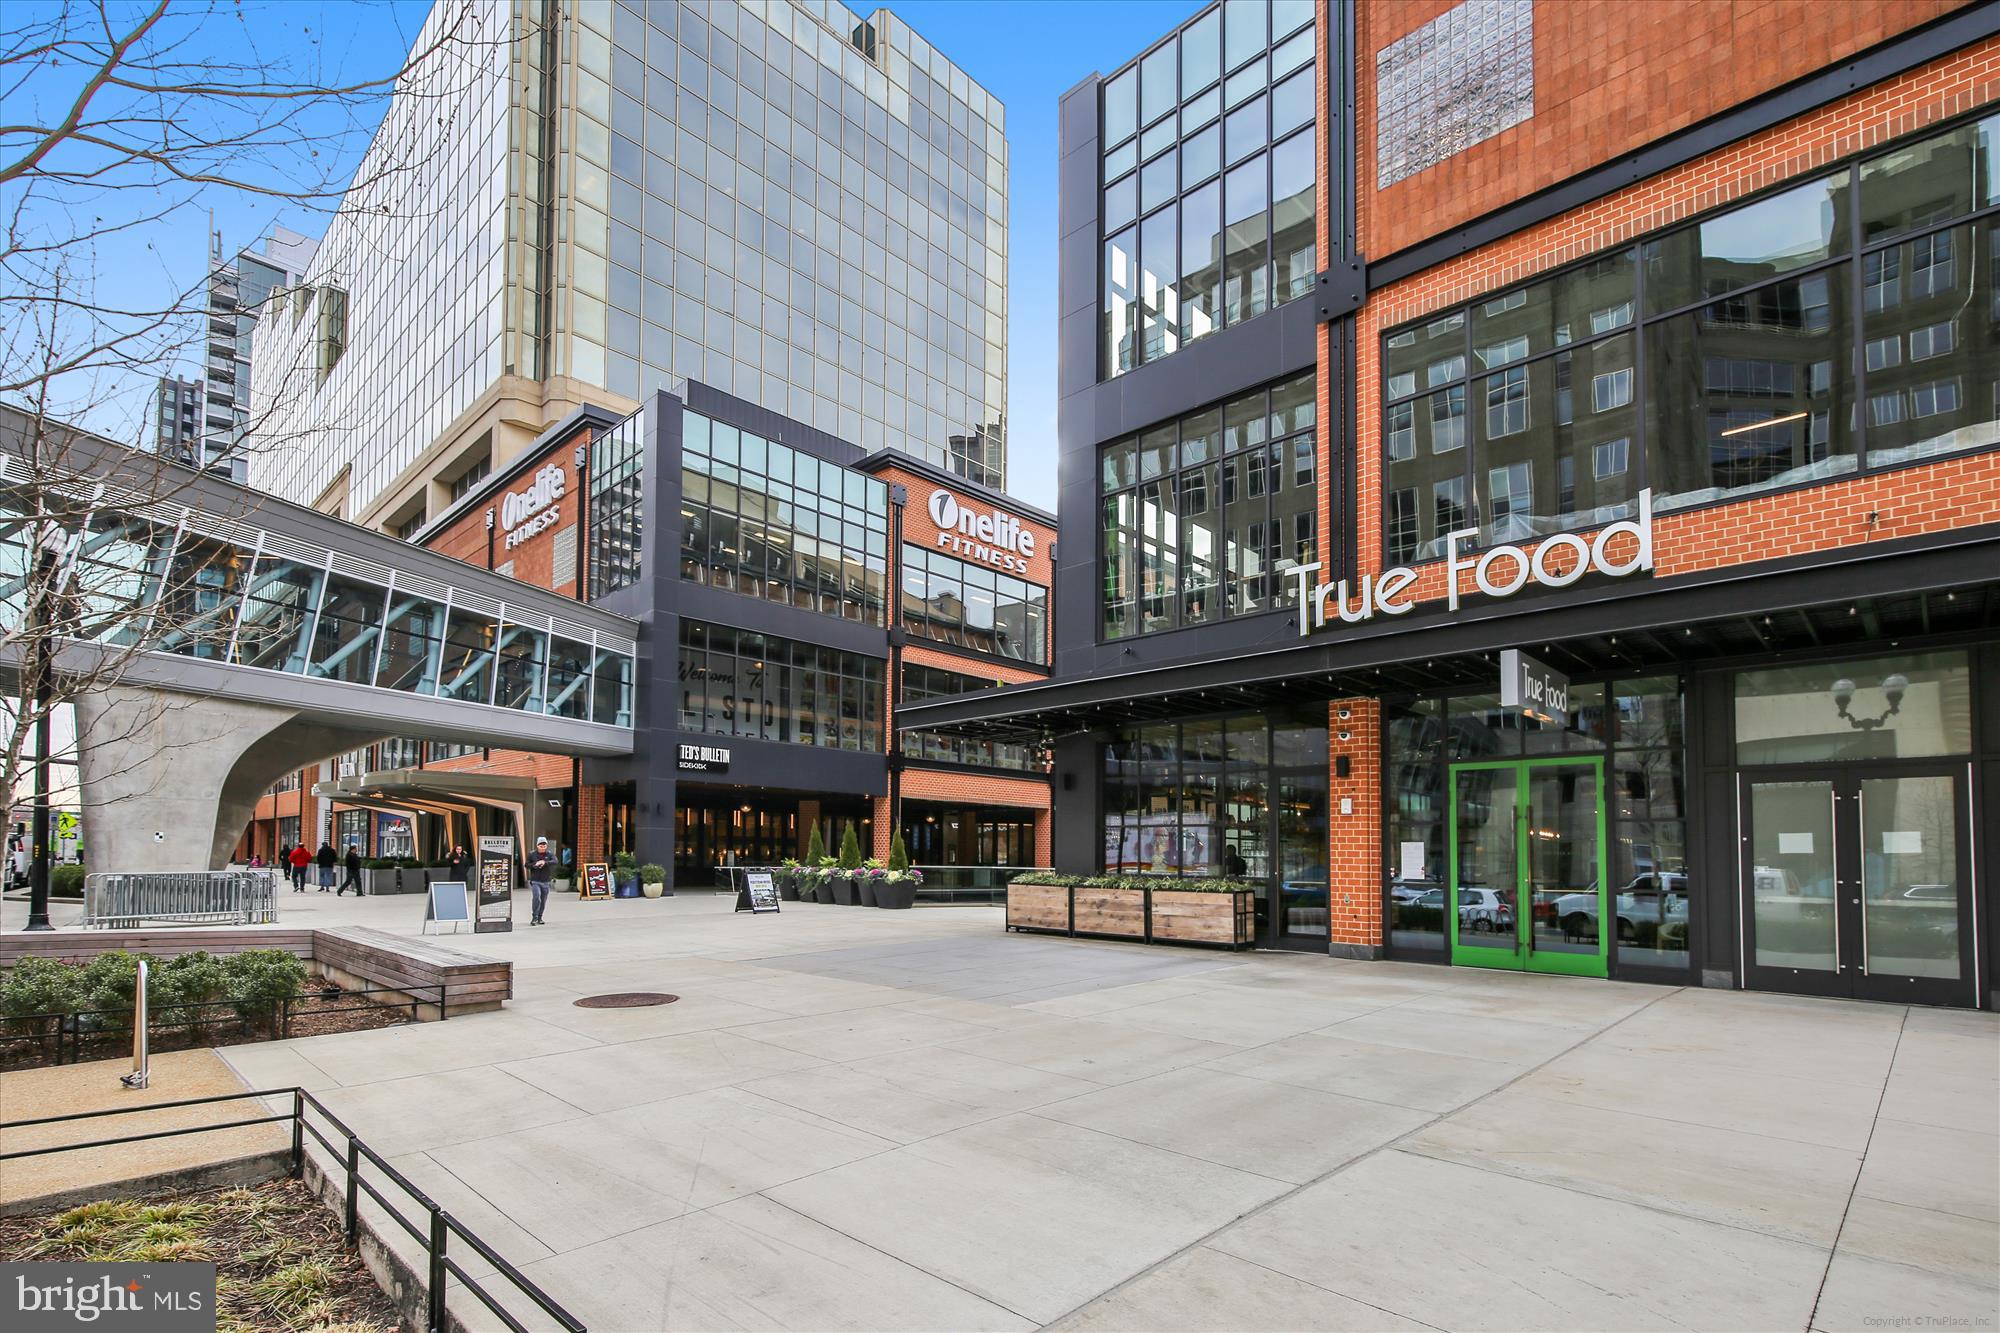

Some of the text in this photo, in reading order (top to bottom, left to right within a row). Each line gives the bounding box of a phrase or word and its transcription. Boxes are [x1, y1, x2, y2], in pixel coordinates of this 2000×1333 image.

[502, 463, 565, 531] Onelife
[505, 504, 560, 550] FITNESS
[928, 489, 1034, 557] Onelife
[937, 531, 1027, 574] FITNESS
[1284, 487, 1654, 636] True Food
[1522, 662, 1567, 712] True Food
[680, 744, 730, 763] TED'S BULLETIN
